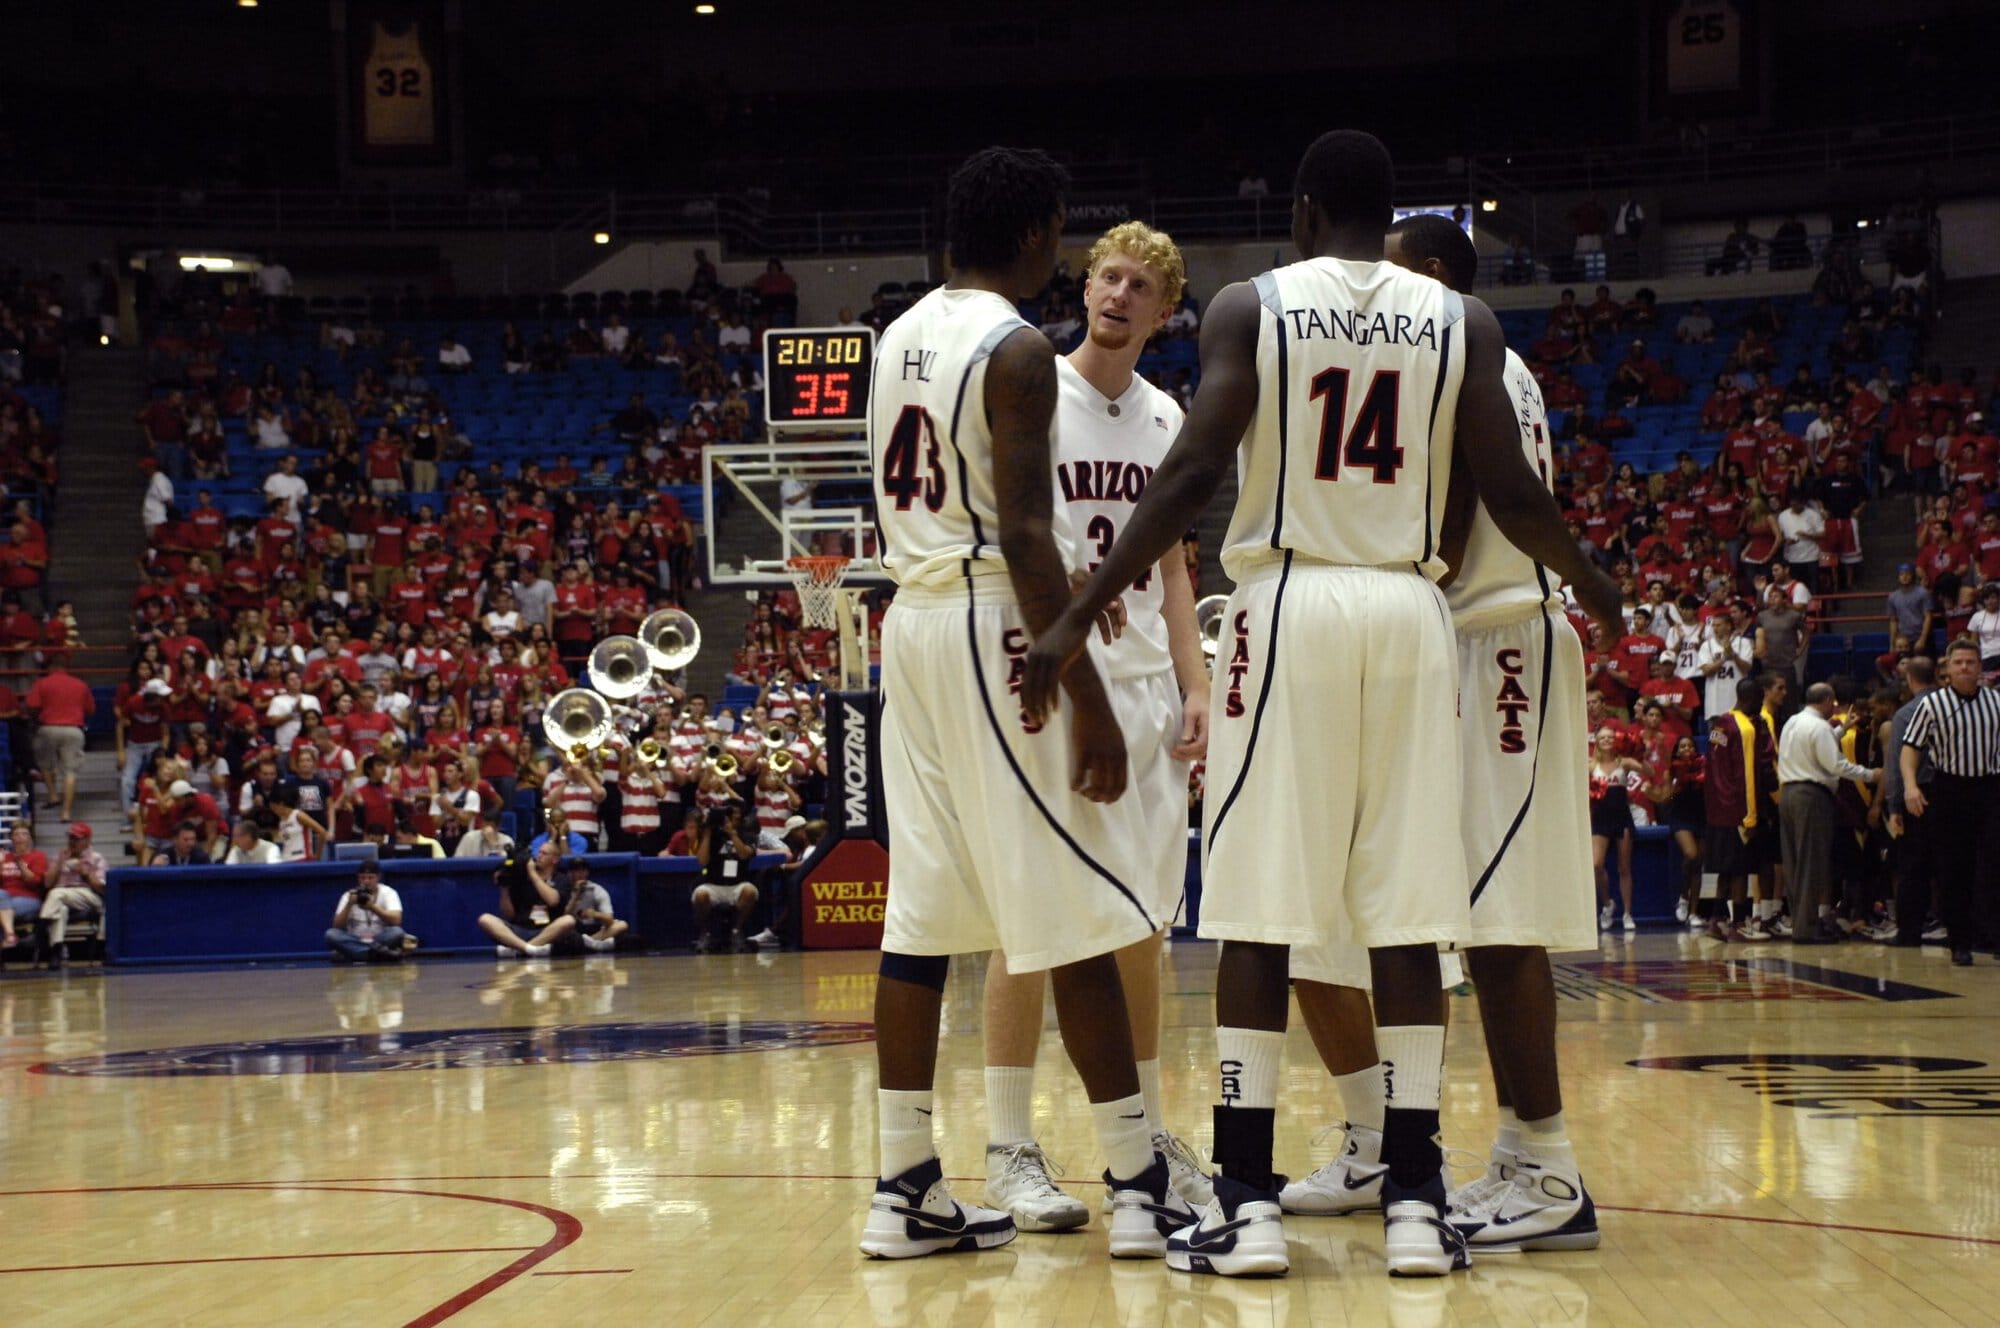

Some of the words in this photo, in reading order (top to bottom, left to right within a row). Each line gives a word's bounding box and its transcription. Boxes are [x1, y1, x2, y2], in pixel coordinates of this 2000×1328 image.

[377, 67, 420, 96] 32
[778, 337, 861, 365] 20:00
[1286, 308, 1437, 351] TANGARA
[792, 373, 850, 416] 35
[1309, 366, 1404, 484] 14
[883, 404, 948, 513] 43
[1225, 608, 1250, 718] CATS
[1680, 653, 1693, 668] 21
[1496, 648, 1530, 754] CATS
[843, 701, 868, 830] ARIZONA
[811, 881, 889, 900] WELL
[815, 903, 885, 923] FARG
